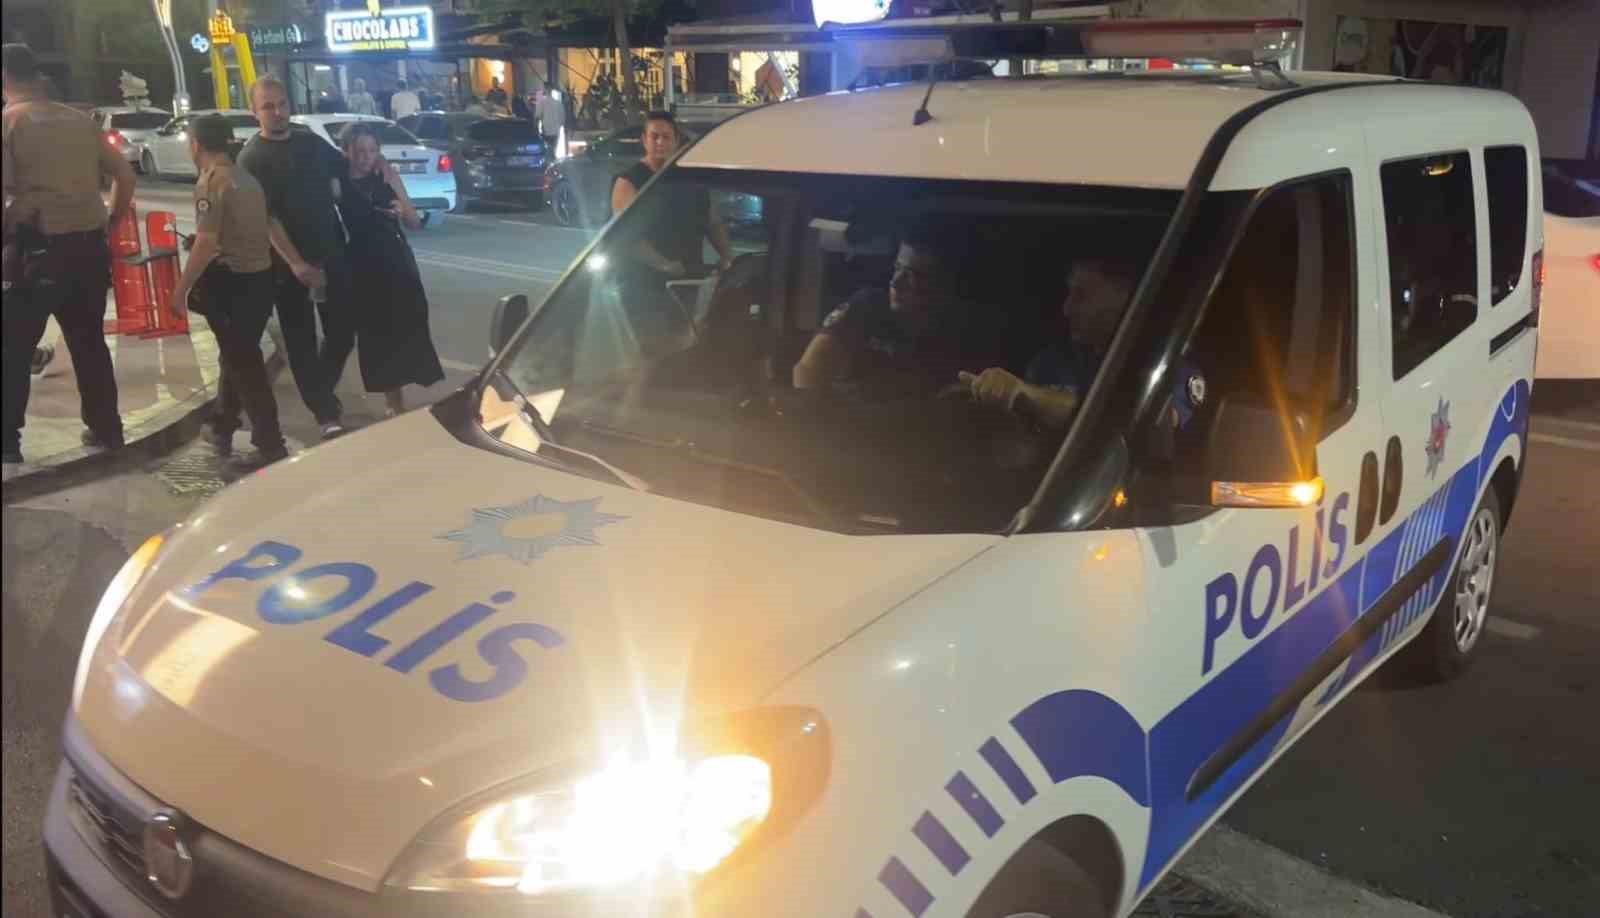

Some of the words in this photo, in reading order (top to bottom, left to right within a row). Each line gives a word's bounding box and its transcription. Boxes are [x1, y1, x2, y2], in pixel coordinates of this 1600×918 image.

[333, 16, 419, 41] CHOCOLABS
[182, 540, 565, 704] POLİS
[1201, 491, 1350, 677] POLİS
